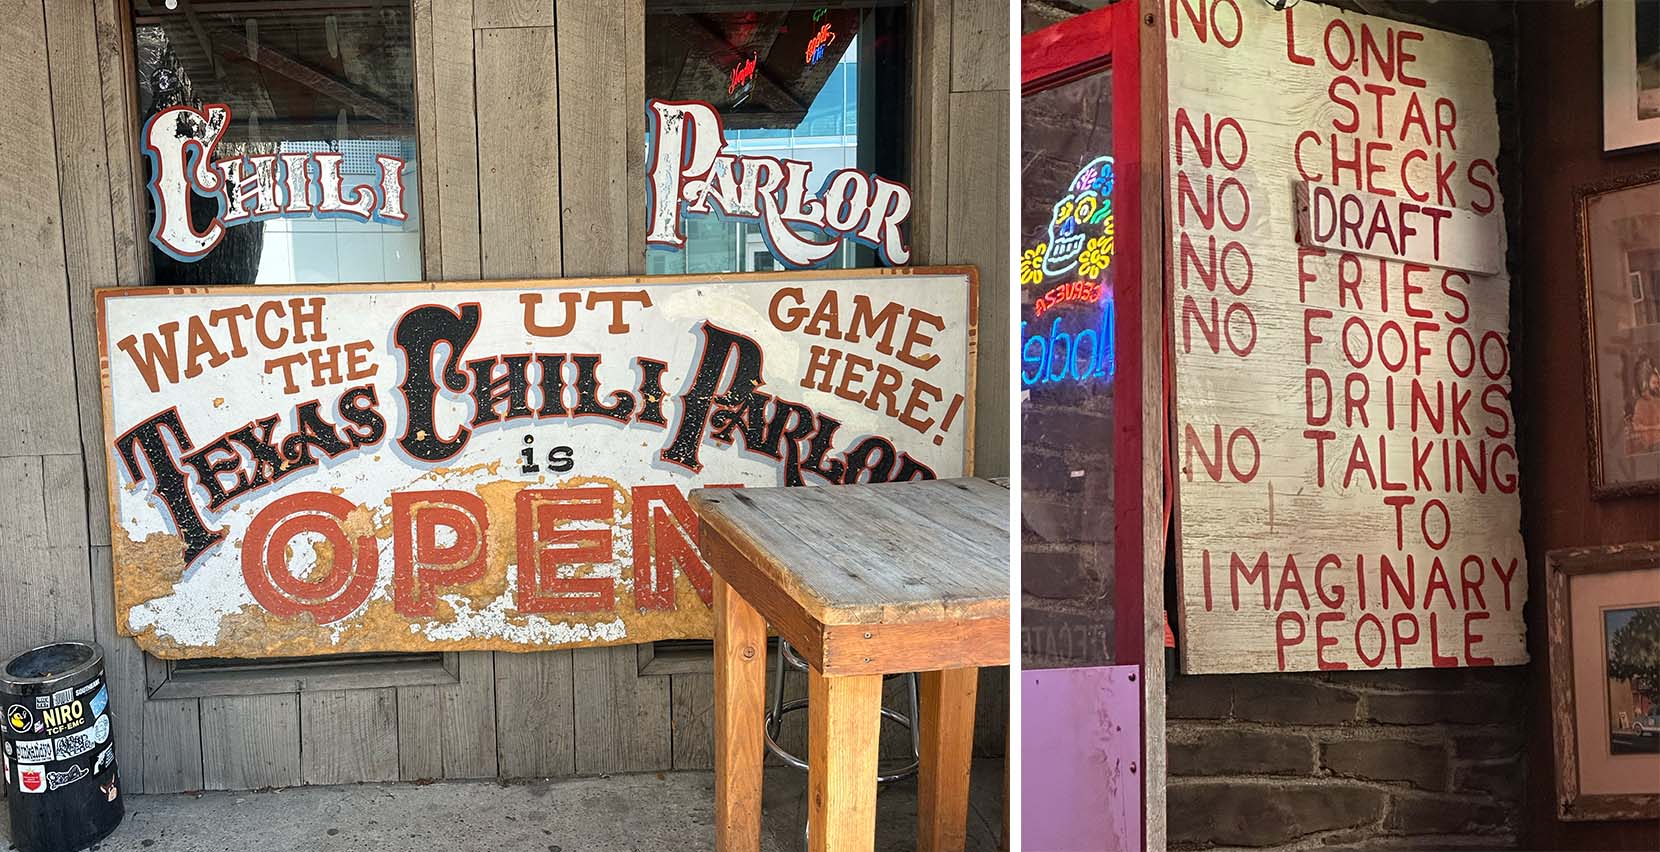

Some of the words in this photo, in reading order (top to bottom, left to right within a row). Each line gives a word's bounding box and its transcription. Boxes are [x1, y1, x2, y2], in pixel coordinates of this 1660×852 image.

[1169, 0, 1243, 48] NO
[1286, 8, 1427, 88] LONE
[1328, 75, 1457, 151] STAR
[143, 103, 409, 262] CHILI
[645, 98, 913, 270] PARLOR
[1175, 107, 1248, 171] NO
[1294, 131, 1496, 215] CHECKS
[1178, 170, 1251, 232] NO
[1313, 186, 1453, 262] DRAFT
[519, 290, 653, 337] UT
[1180, 231, 1253, 296] NO
[1297, 247, 1471, 324] FRIES
[117, 297, 329, 393] WATCH
[264, 339, 379, 395] THE
[768, 287, 946, 371] GAME
[1182, 295, 1257, 357] NO
[1303, 309, 1508, 381] FOOFOO
[113, 384, 387, 571] TEXAS
[392, 301, 669, 462] CHILI
[800, 345, 965, 446] HERE!
[1305, 368, 1510, 439] DRINKS
[520, 434, 575, 474] is
[1184, 423, 1260, 483] NO
[1303, 430, 1518, 494] TALKING
[240, 483, 745, 626] OPEN
[1384, 496, 1451, 551] TO
[1203, 549, 1518, 612] IMAGINARY
[1275, 611, 1494, 671] PEOPLE
[43, 700, 83, 728] NIRO
